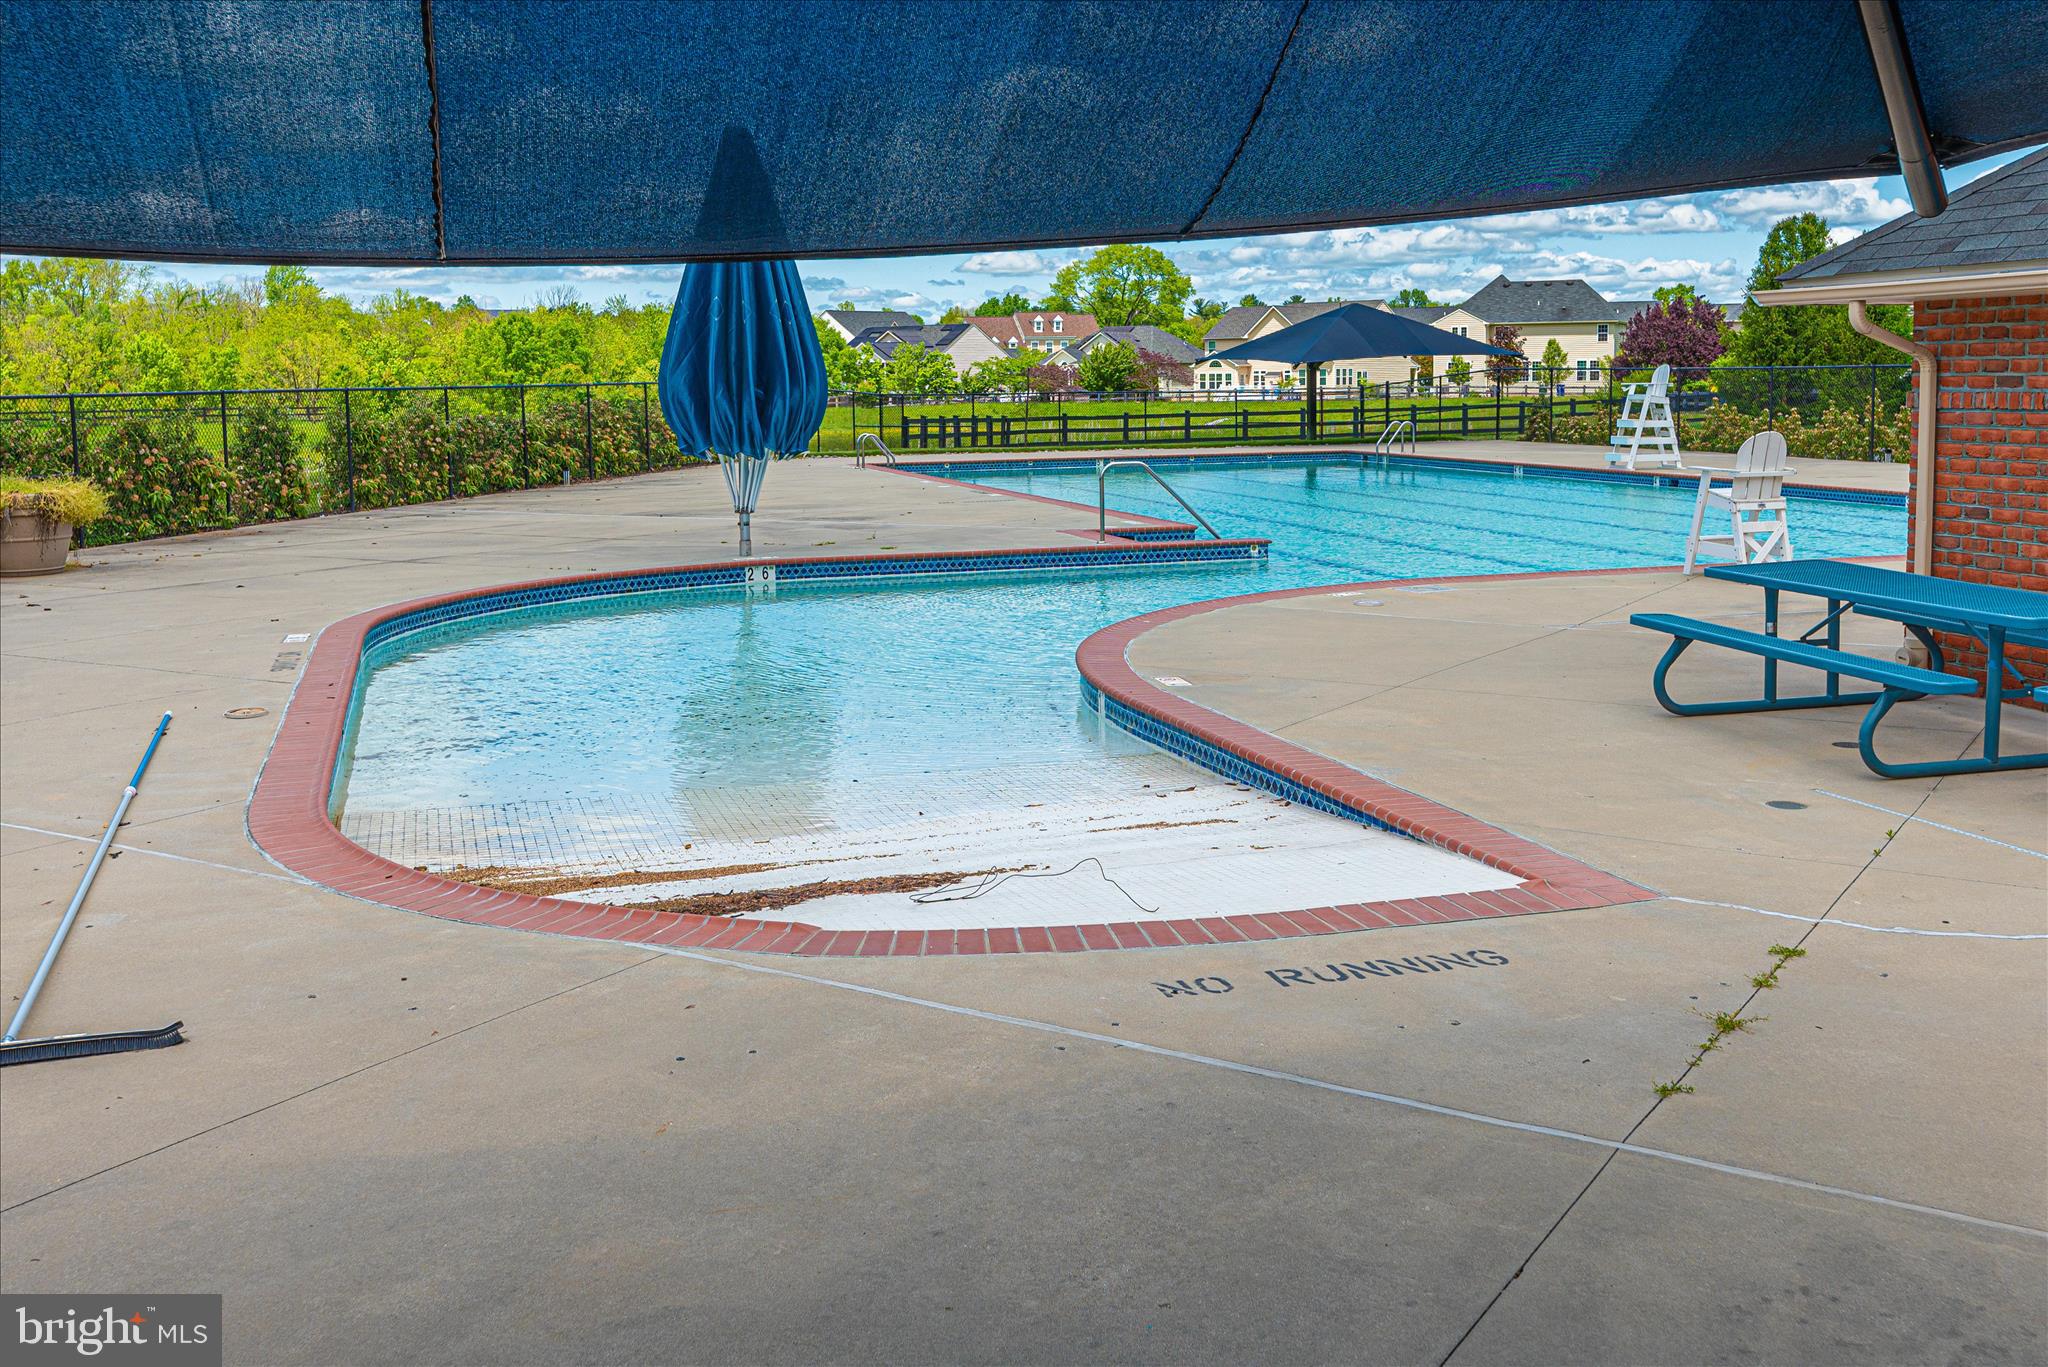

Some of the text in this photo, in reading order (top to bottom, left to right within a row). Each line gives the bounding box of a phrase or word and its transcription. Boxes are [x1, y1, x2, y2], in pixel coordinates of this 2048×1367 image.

[747, 566, 769, 581] 2 6
[1151, 949, 1510, 998] NO RUNNING
